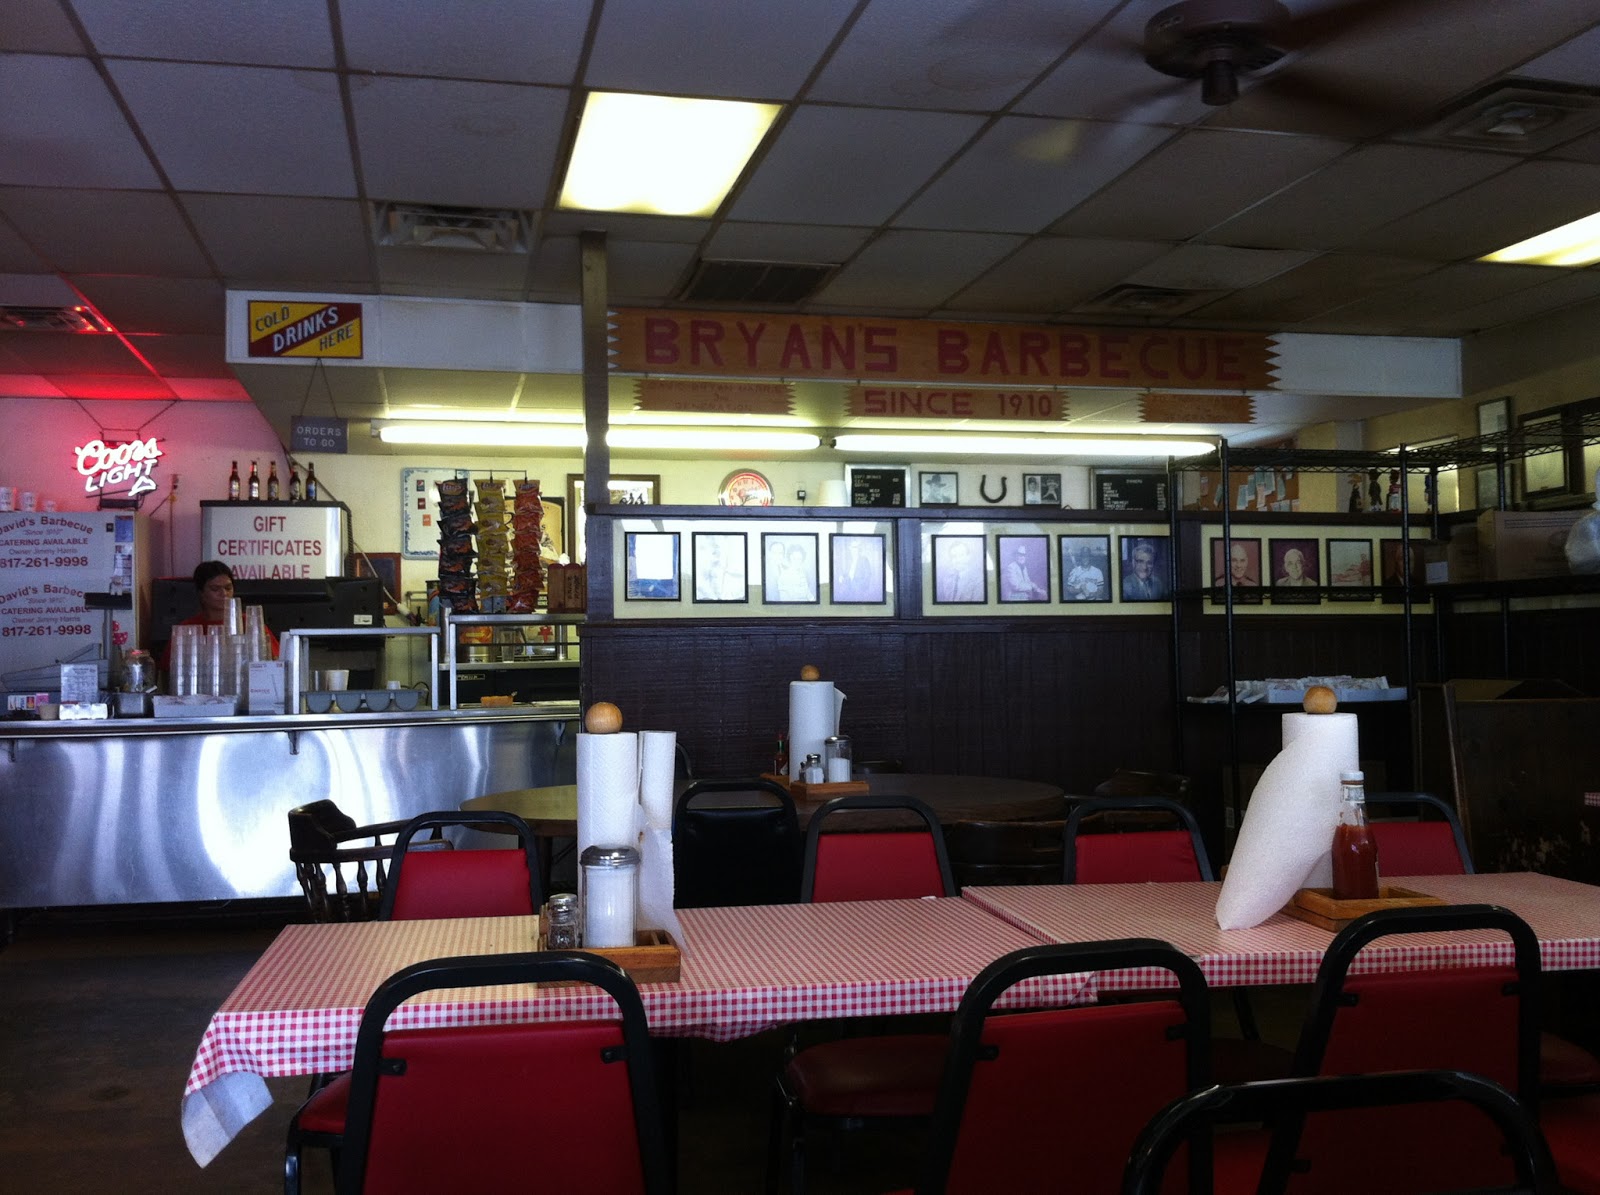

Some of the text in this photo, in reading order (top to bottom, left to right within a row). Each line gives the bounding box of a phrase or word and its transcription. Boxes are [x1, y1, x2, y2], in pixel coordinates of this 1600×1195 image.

[255, 306, 290, 332] COLD
[273, 306, 339, 352] DRINKS
[319, 322, 354, 351] HERE
[645, 317, 1246, 382] BRYAN'S BARBECUE
[864, 390, 1051, 417] SINCE 1910
[296, 426, 342, 437] ORDERS
[304, 437, 335, 448] TO GO
[85, 459, 158, 493] LIGHT
[40, 516, 94, 535] Barbecue
[253, 516, 286, 532] GIFT
[0, 538, 88, 547] CATERING AVAILABLE
[218, 540, 322, 556] CERTIFICATES
[0, 556, 88, 568] 817-261-9998
[232, 565, 310, 579] AVAILABLE
[43, 584, 86, 599] Barbec
[1, 607, 43, 615] CATERING
[2, 625, 91, 637] 817-261-9998
